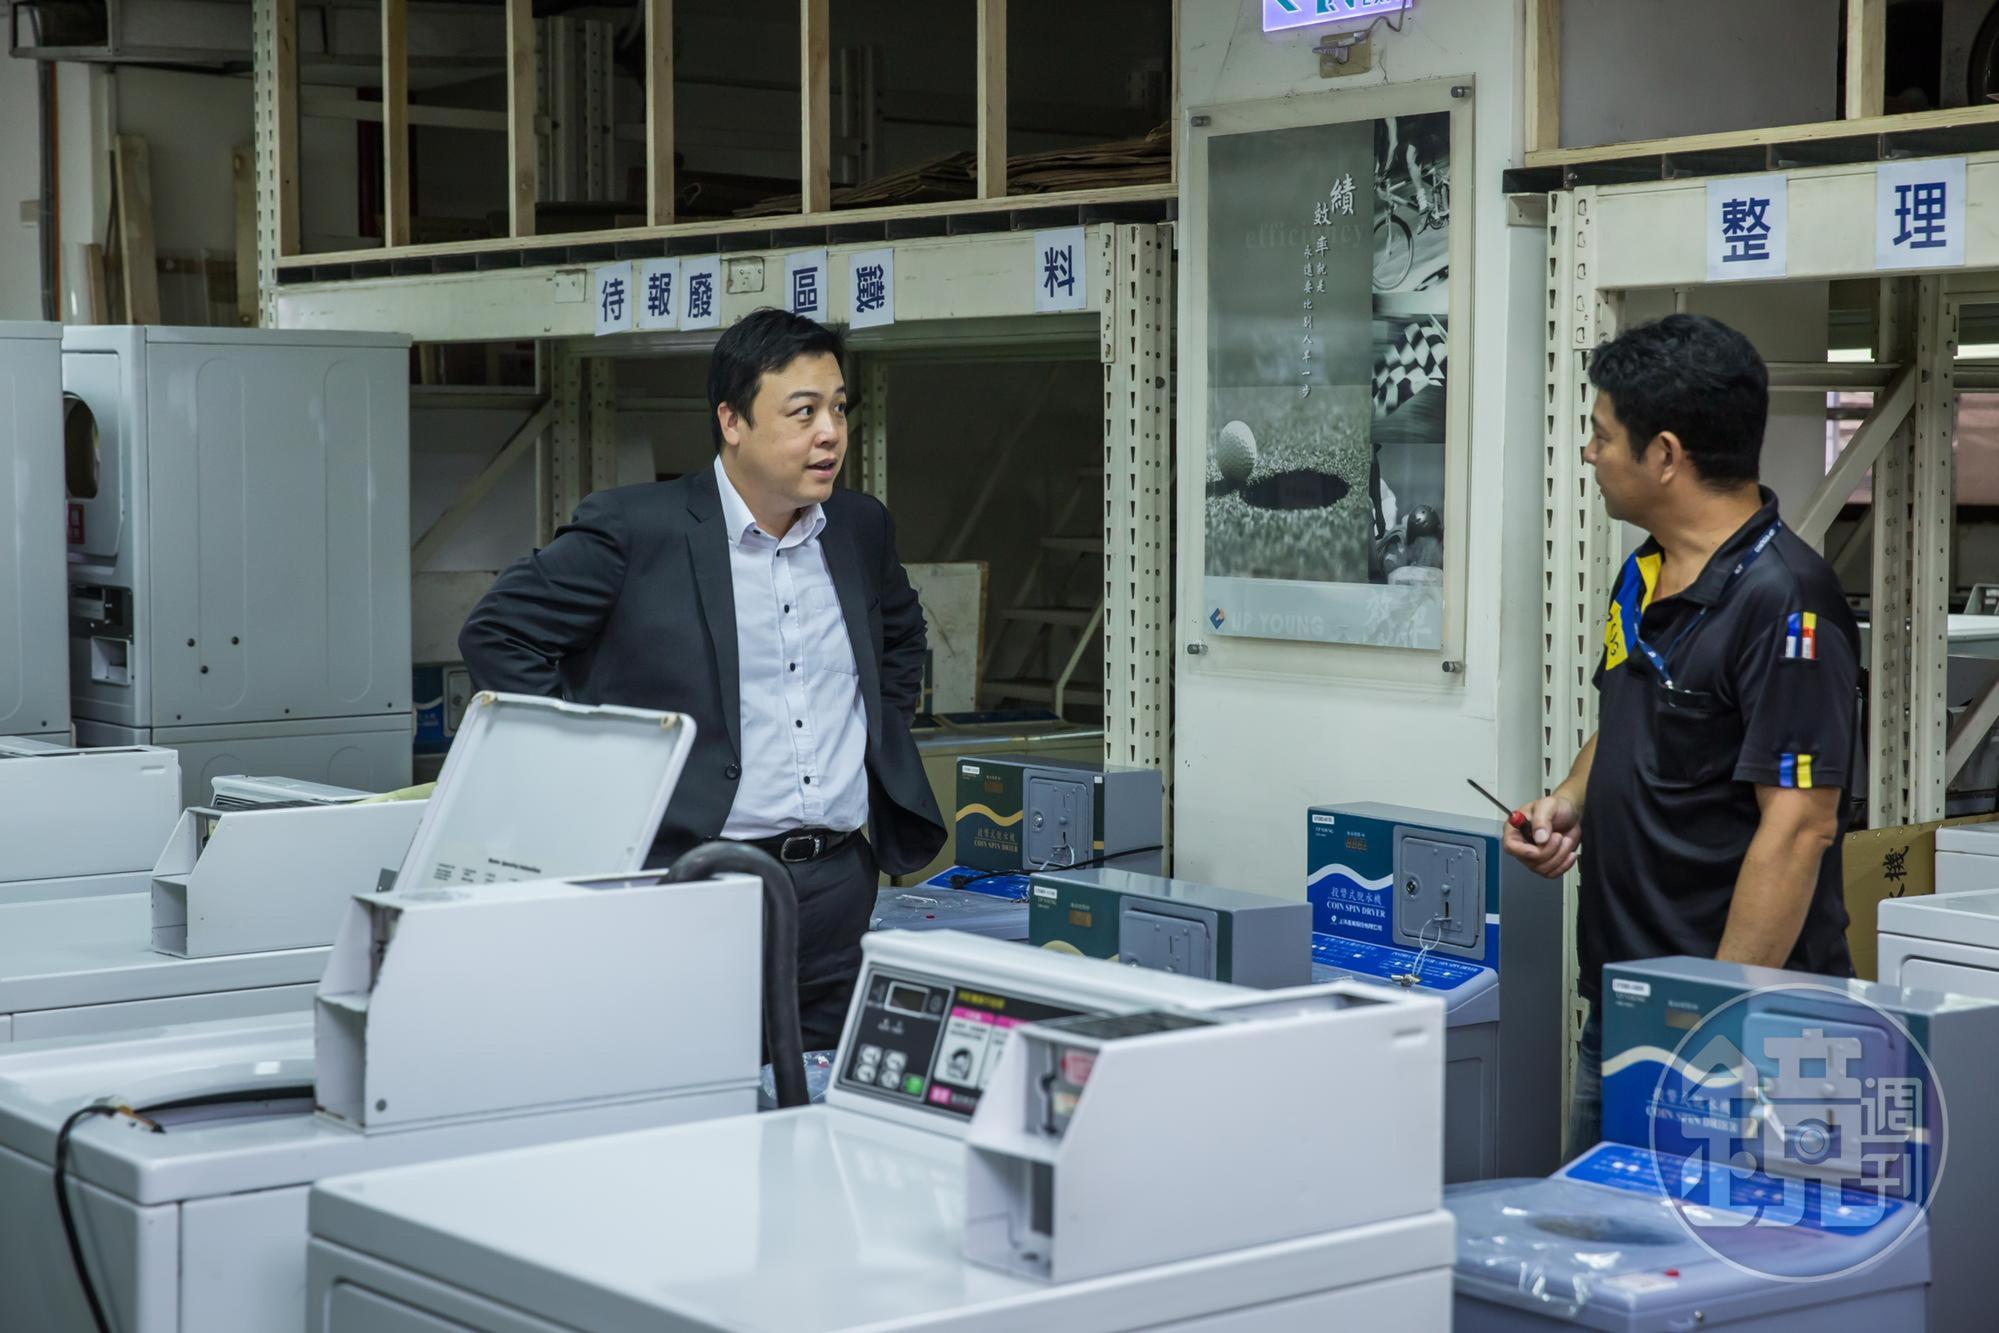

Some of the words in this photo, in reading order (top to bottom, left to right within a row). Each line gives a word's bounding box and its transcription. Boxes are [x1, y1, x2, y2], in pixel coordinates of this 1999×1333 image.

[1722, 197, 1771, 262] 整
[1892, 182, 1947, 249] 理
[1044, 244, 1076, 299] 料
[1231, 613, 1254, 632] UP
[1257, 614, 1325, 636] YOUNG
[1327, 901, 1344, 910] COIN
[1345, 904, 1360, 913] SPIN
